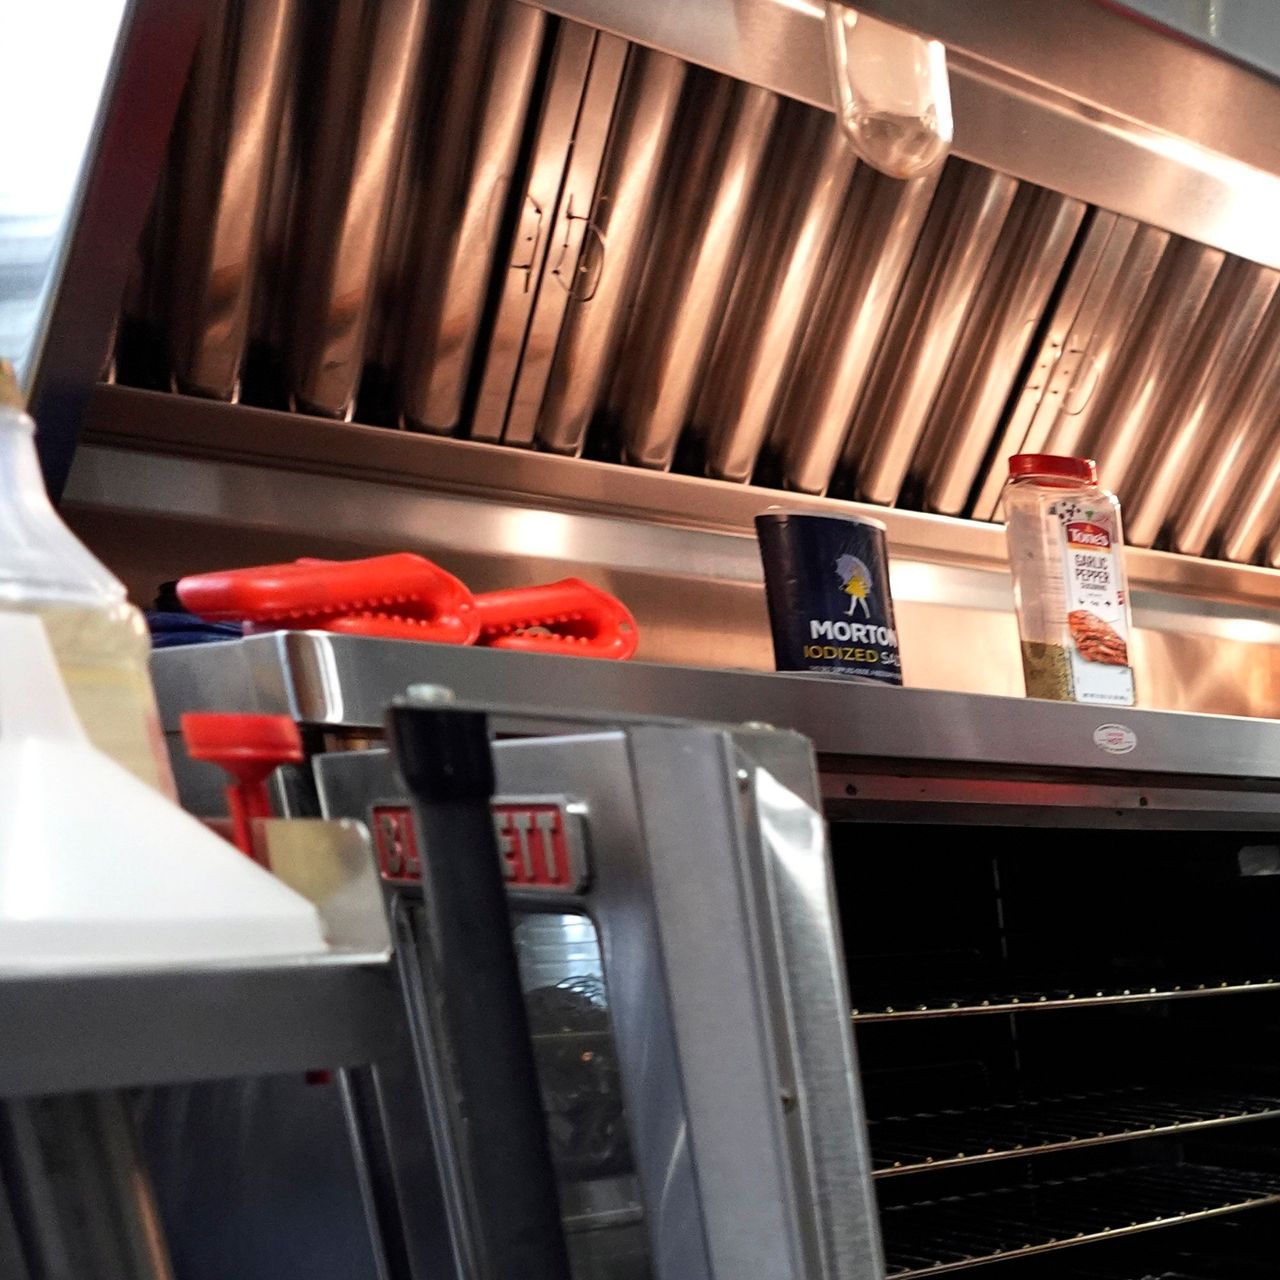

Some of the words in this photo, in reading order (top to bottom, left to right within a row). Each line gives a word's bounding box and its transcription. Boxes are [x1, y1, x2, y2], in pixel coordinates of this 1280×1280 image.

[1074, 553, 1108, 570] GARLIC
[1074, 568, 1110, 584] PEPPER
[803, 645, 880, 663] IODIZED
[880, 651, 901, 667] SAL
[380, 811, 557, 881] BLETT
